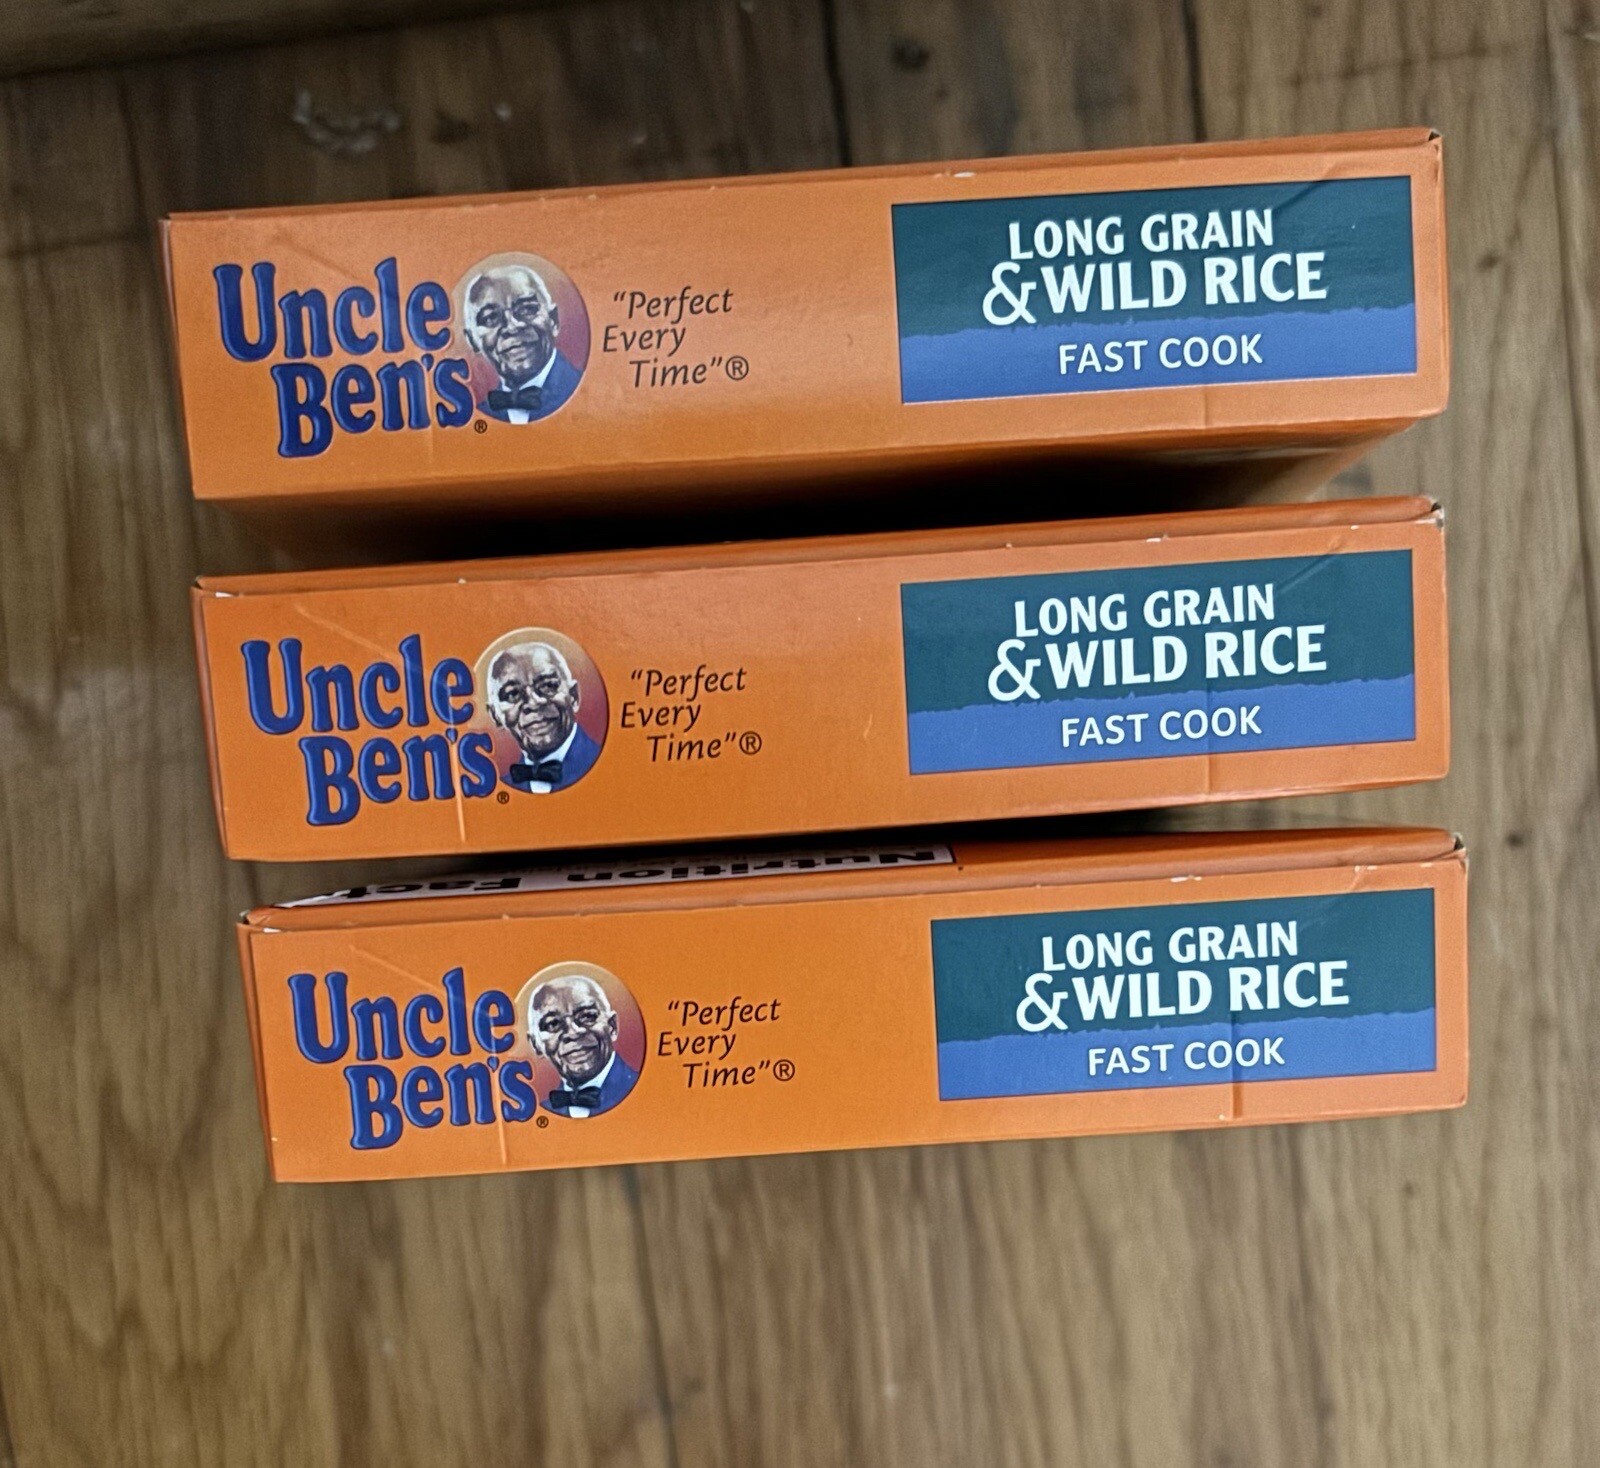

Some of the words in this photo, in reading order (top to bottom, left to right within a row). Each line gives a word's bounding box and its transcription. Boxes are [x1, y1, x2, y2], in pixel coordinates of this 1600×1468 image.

[1009, 216, 1124, 260] LONG
[1140, 208, 1274, 252] GRAIN
[1203, 251, 1328, 305] RICE
[213, 256, 451, 362] Uncle
[603, 325, 686, 353] Every
[1058, 339, 1148, 375] FAST
[1158, 333, 1263, 370] COOK
[1014, 593, 1128, 638] LONG
[1143, 583, 1275, 627] GRAIN
[1204, 624, 1327, 679] RICE
[240, 632, 474, 735] Uncle
[620, 702, 701, 732] Every
[1061, 713, 1149, 748] FAST
[1158, 705, 1263, 742] COOK
[566, 849, 935, 882] Nutrition
[1042, 929, 1153, 972] LONG
[1168, 920, 1298, 963] GRAIN
[1228, 960, 1350, 1011] RICE
[288, 966, 515, 1064] Uncle
[657, 1030, 736, 1060] Every
[1087, 1043, 1175, 1076] FAST
[1183, 1036, 1286, 1071] COOK
